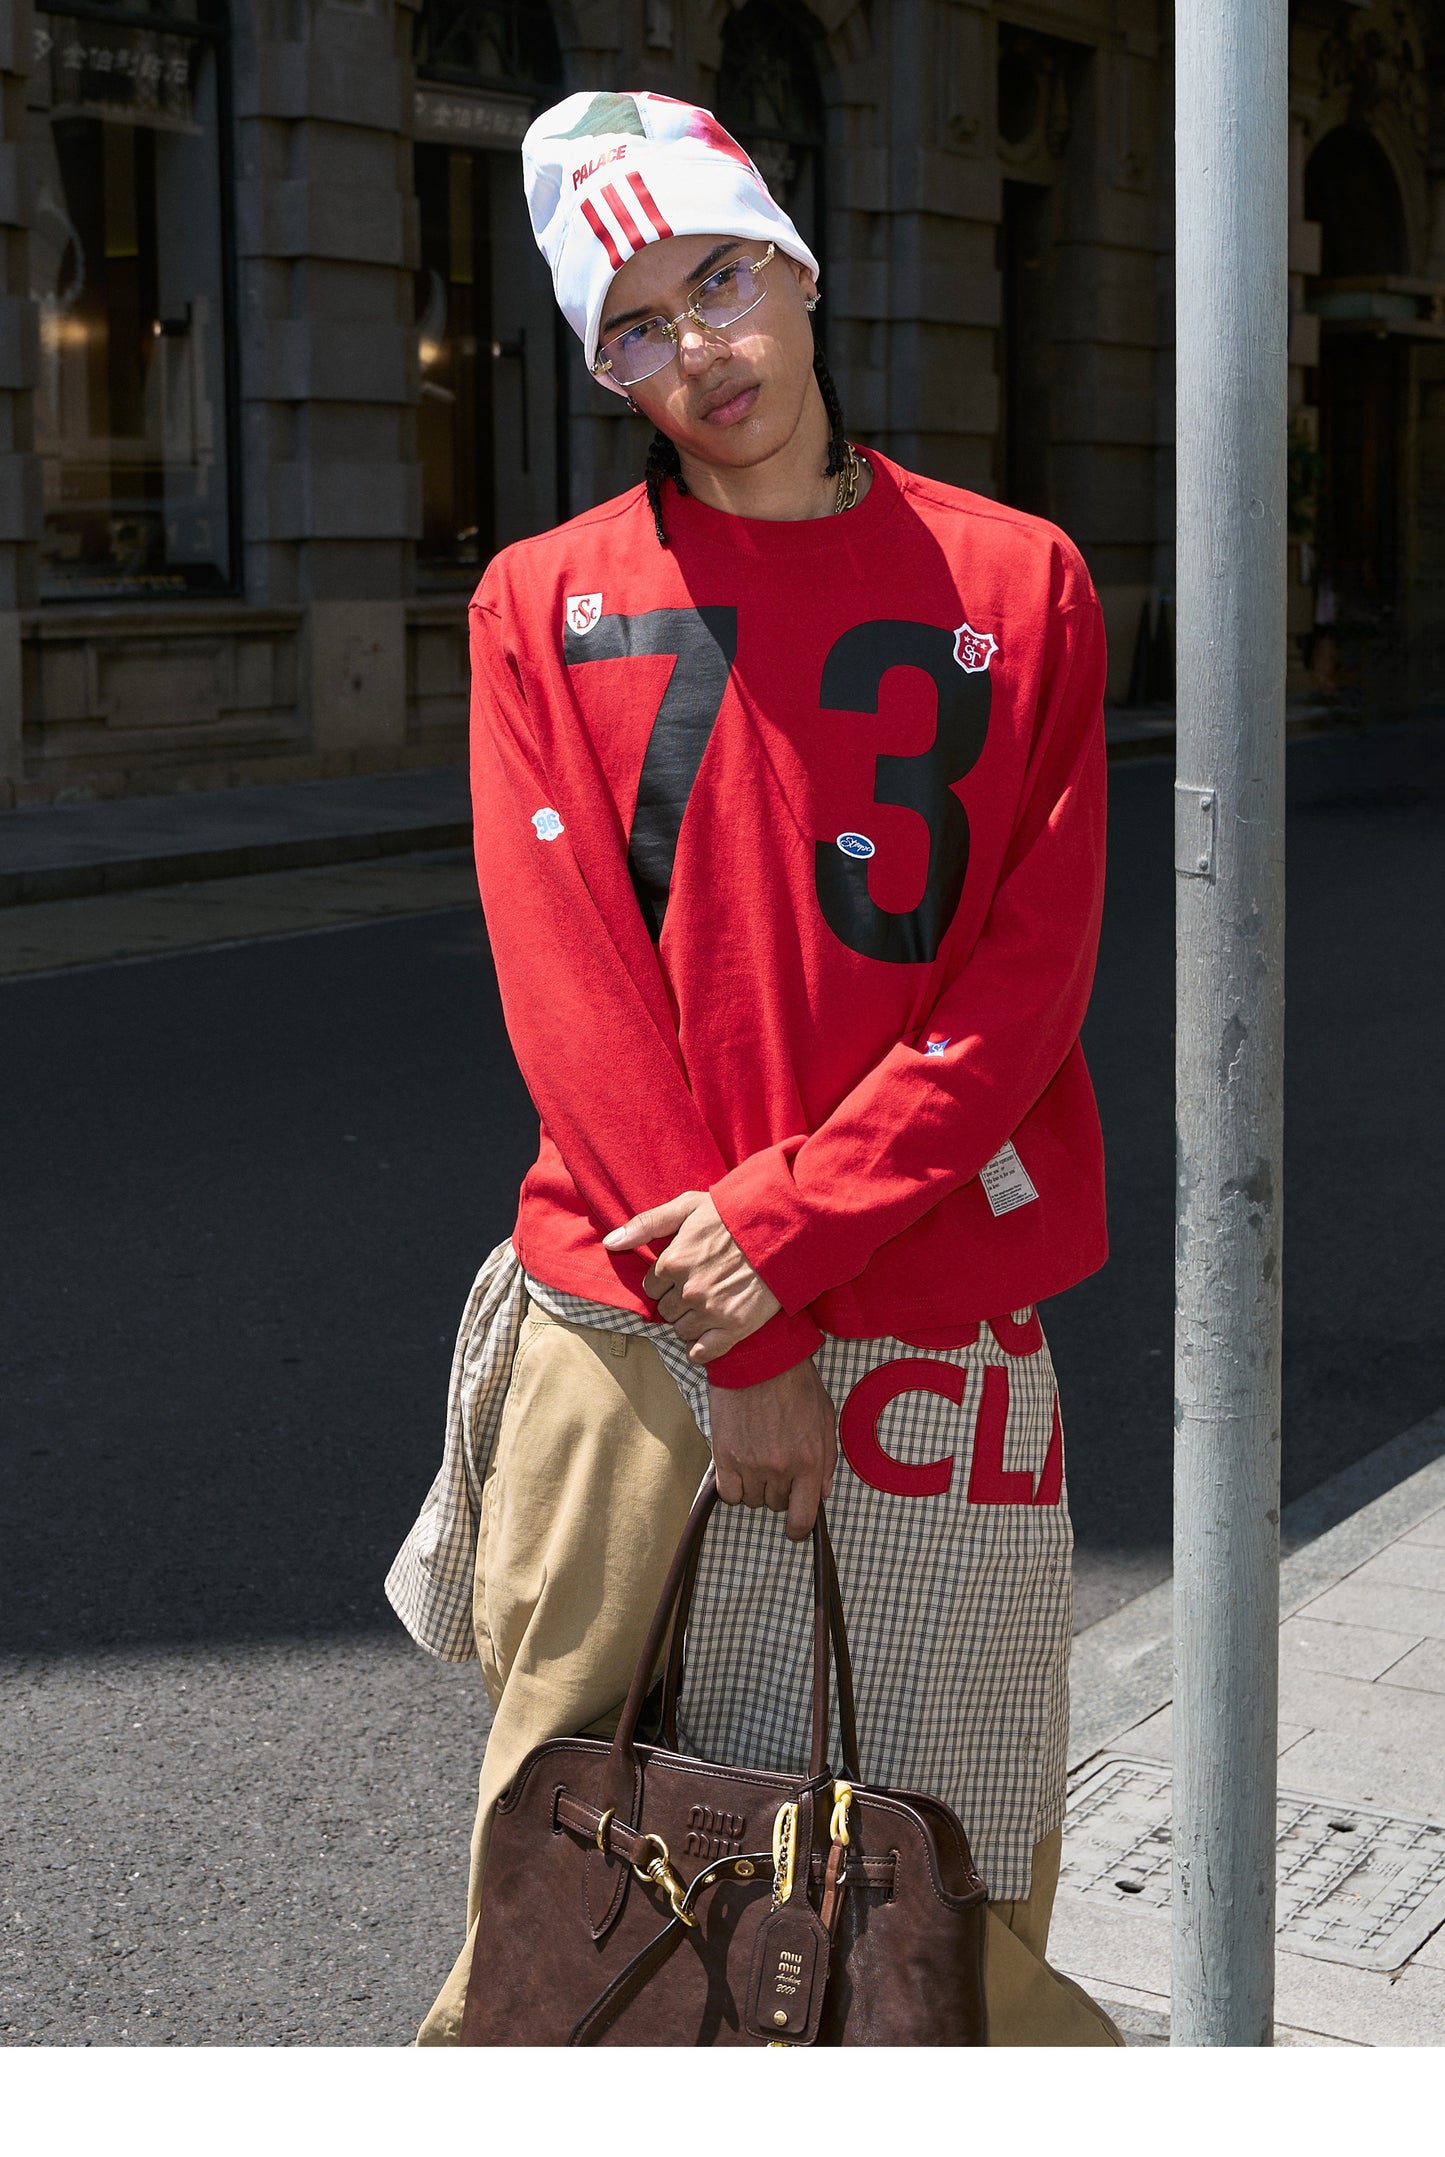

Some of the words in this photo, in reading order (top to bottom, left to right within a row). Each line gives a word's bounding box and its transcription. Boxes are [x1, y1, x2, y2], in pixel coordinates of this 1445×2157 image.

[572, 144, 627, 191] PALACE
[536, 813, 560, 834] 96
[776, 1984, 796, 1995] 2009
